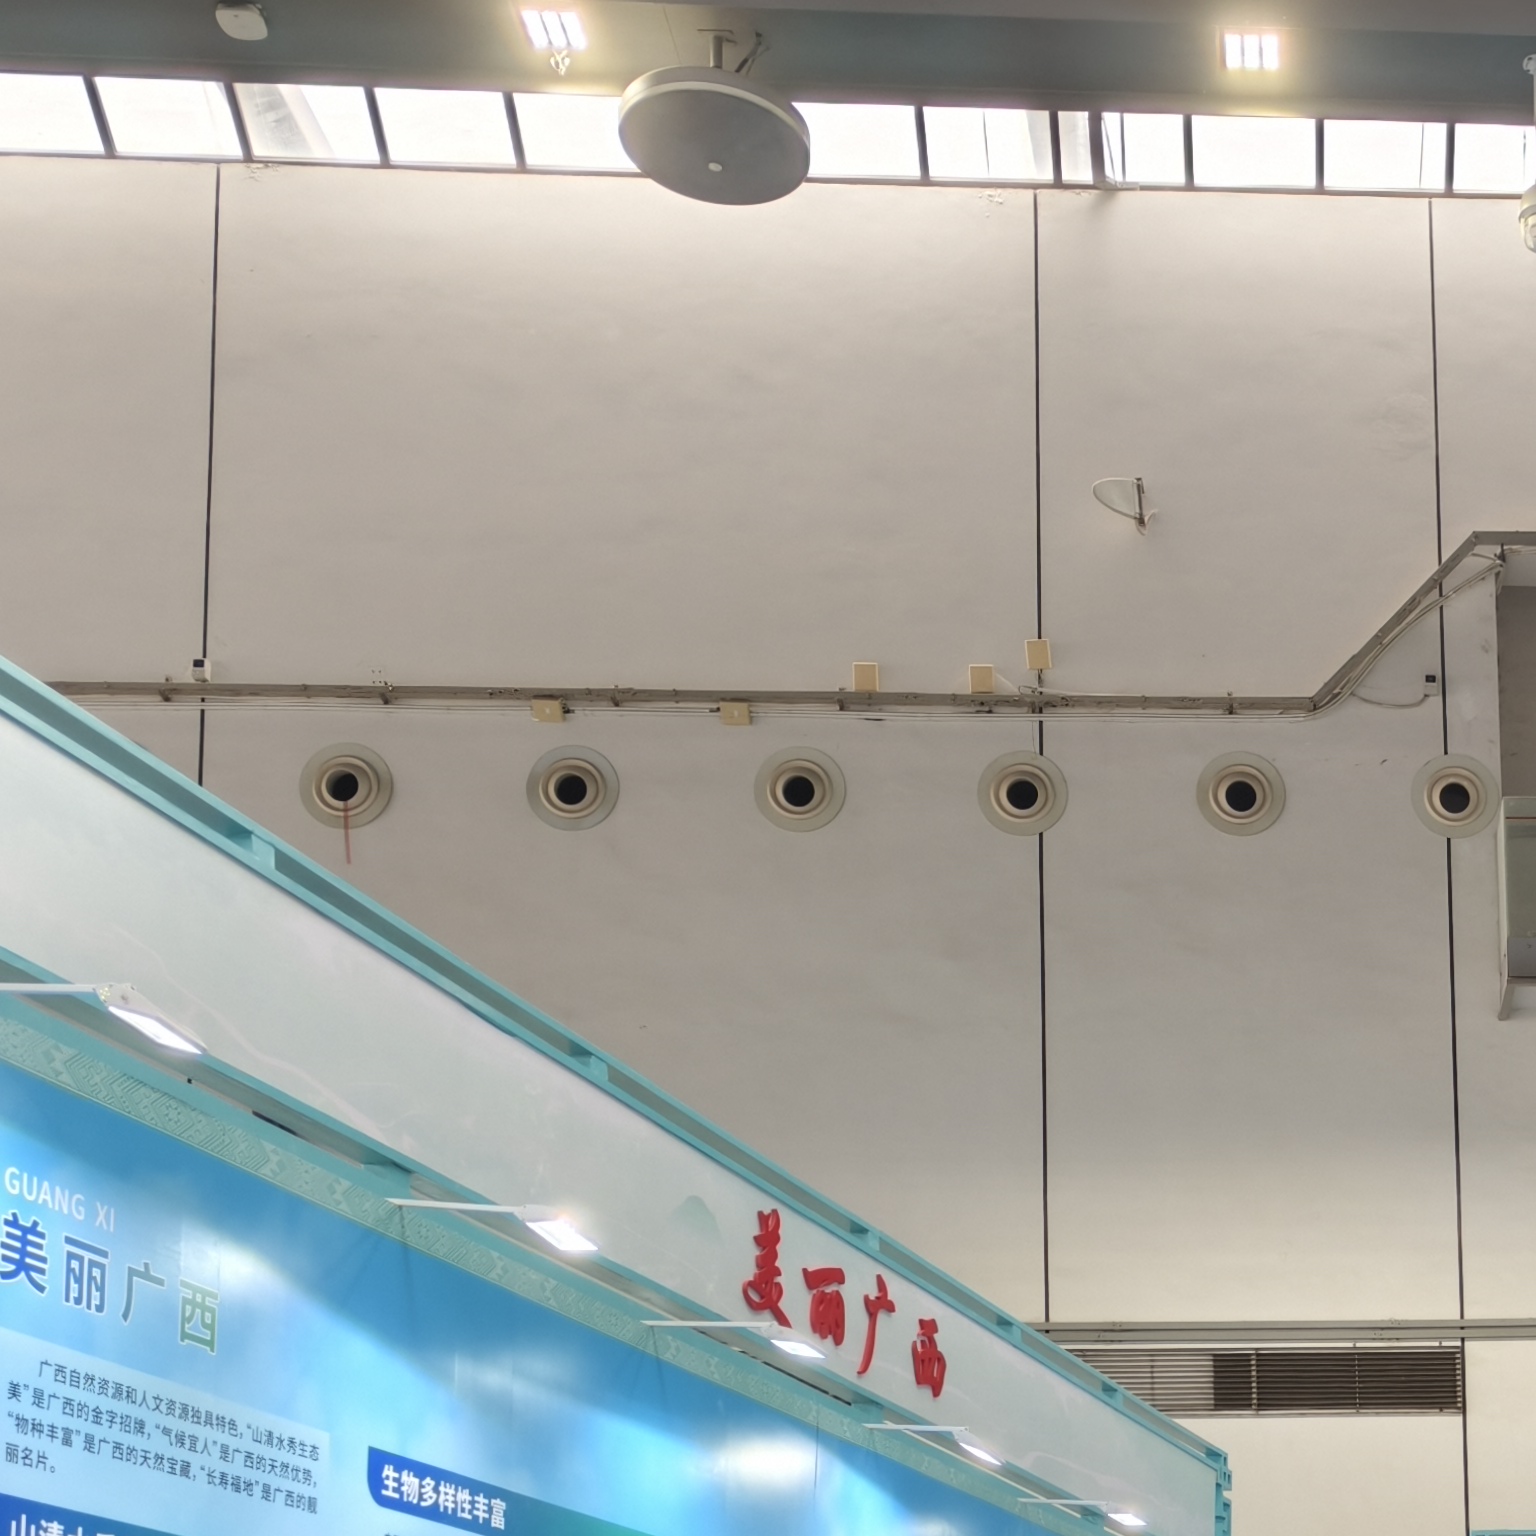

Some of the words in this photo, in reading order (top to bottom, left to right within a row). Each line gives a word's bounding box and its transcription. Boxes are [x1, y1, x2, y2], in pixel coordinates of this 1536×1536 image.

[4, 1167, 86, 1221] GUANG
[95, 1201, 116, 1233] XI
[0, 1210, 220, 1355] 美丽广西
[742, 1208, 947, 1398] 美丽广西
[5, 1441, 55, 1473] 丽名片。
[381, 1464, 507, 1530] 生物多样性丰富
